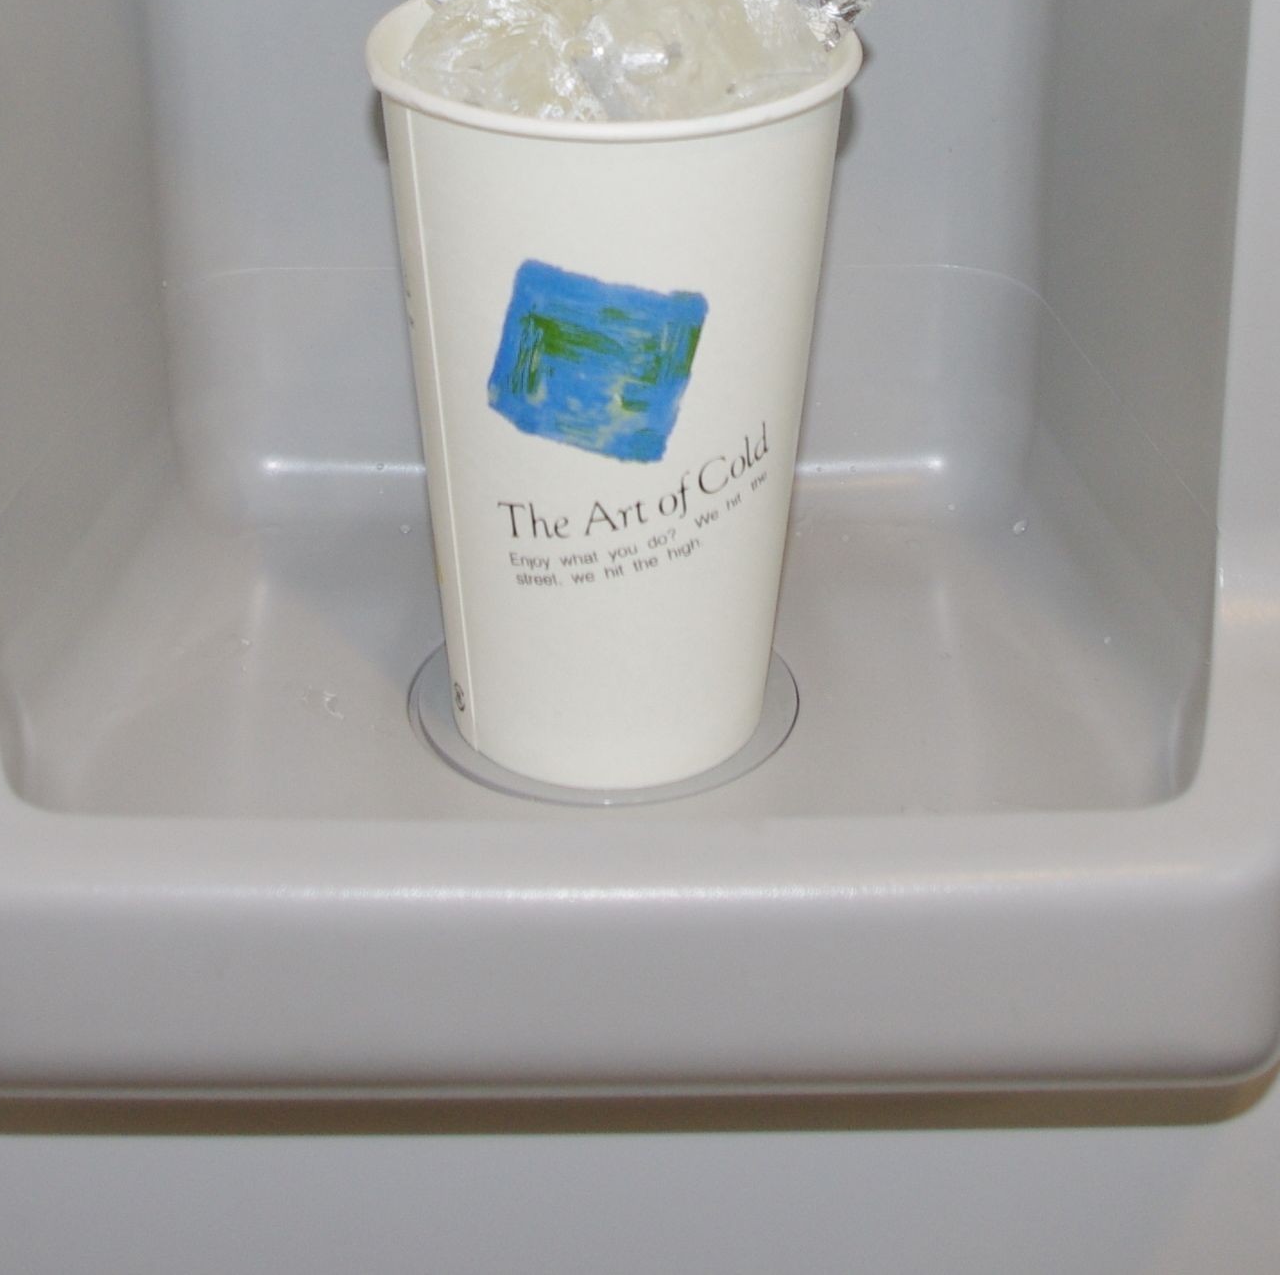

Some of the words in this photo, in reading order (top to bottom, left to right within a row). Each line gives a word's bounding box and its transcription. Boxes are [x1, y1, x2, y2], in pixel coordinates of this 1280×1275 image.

[497, 501, 570, 540] The
[584, 500, 649, 537] Art
[658, 470, 691, 520] of
[698, 421, 770, 495] Cold
[509, 551, 551, 571] Enjoy
[560, 551, 600, 567] what
[608, 544, 639, 563] you
[648, 528, 677, 549] do?
[694, 510, 720, 528] We
[726, 492, 743, 511] hit
[571, 572, 595, 584] we
[604, 565, 624, 580] hit
[633, 555, 659, 573] the
